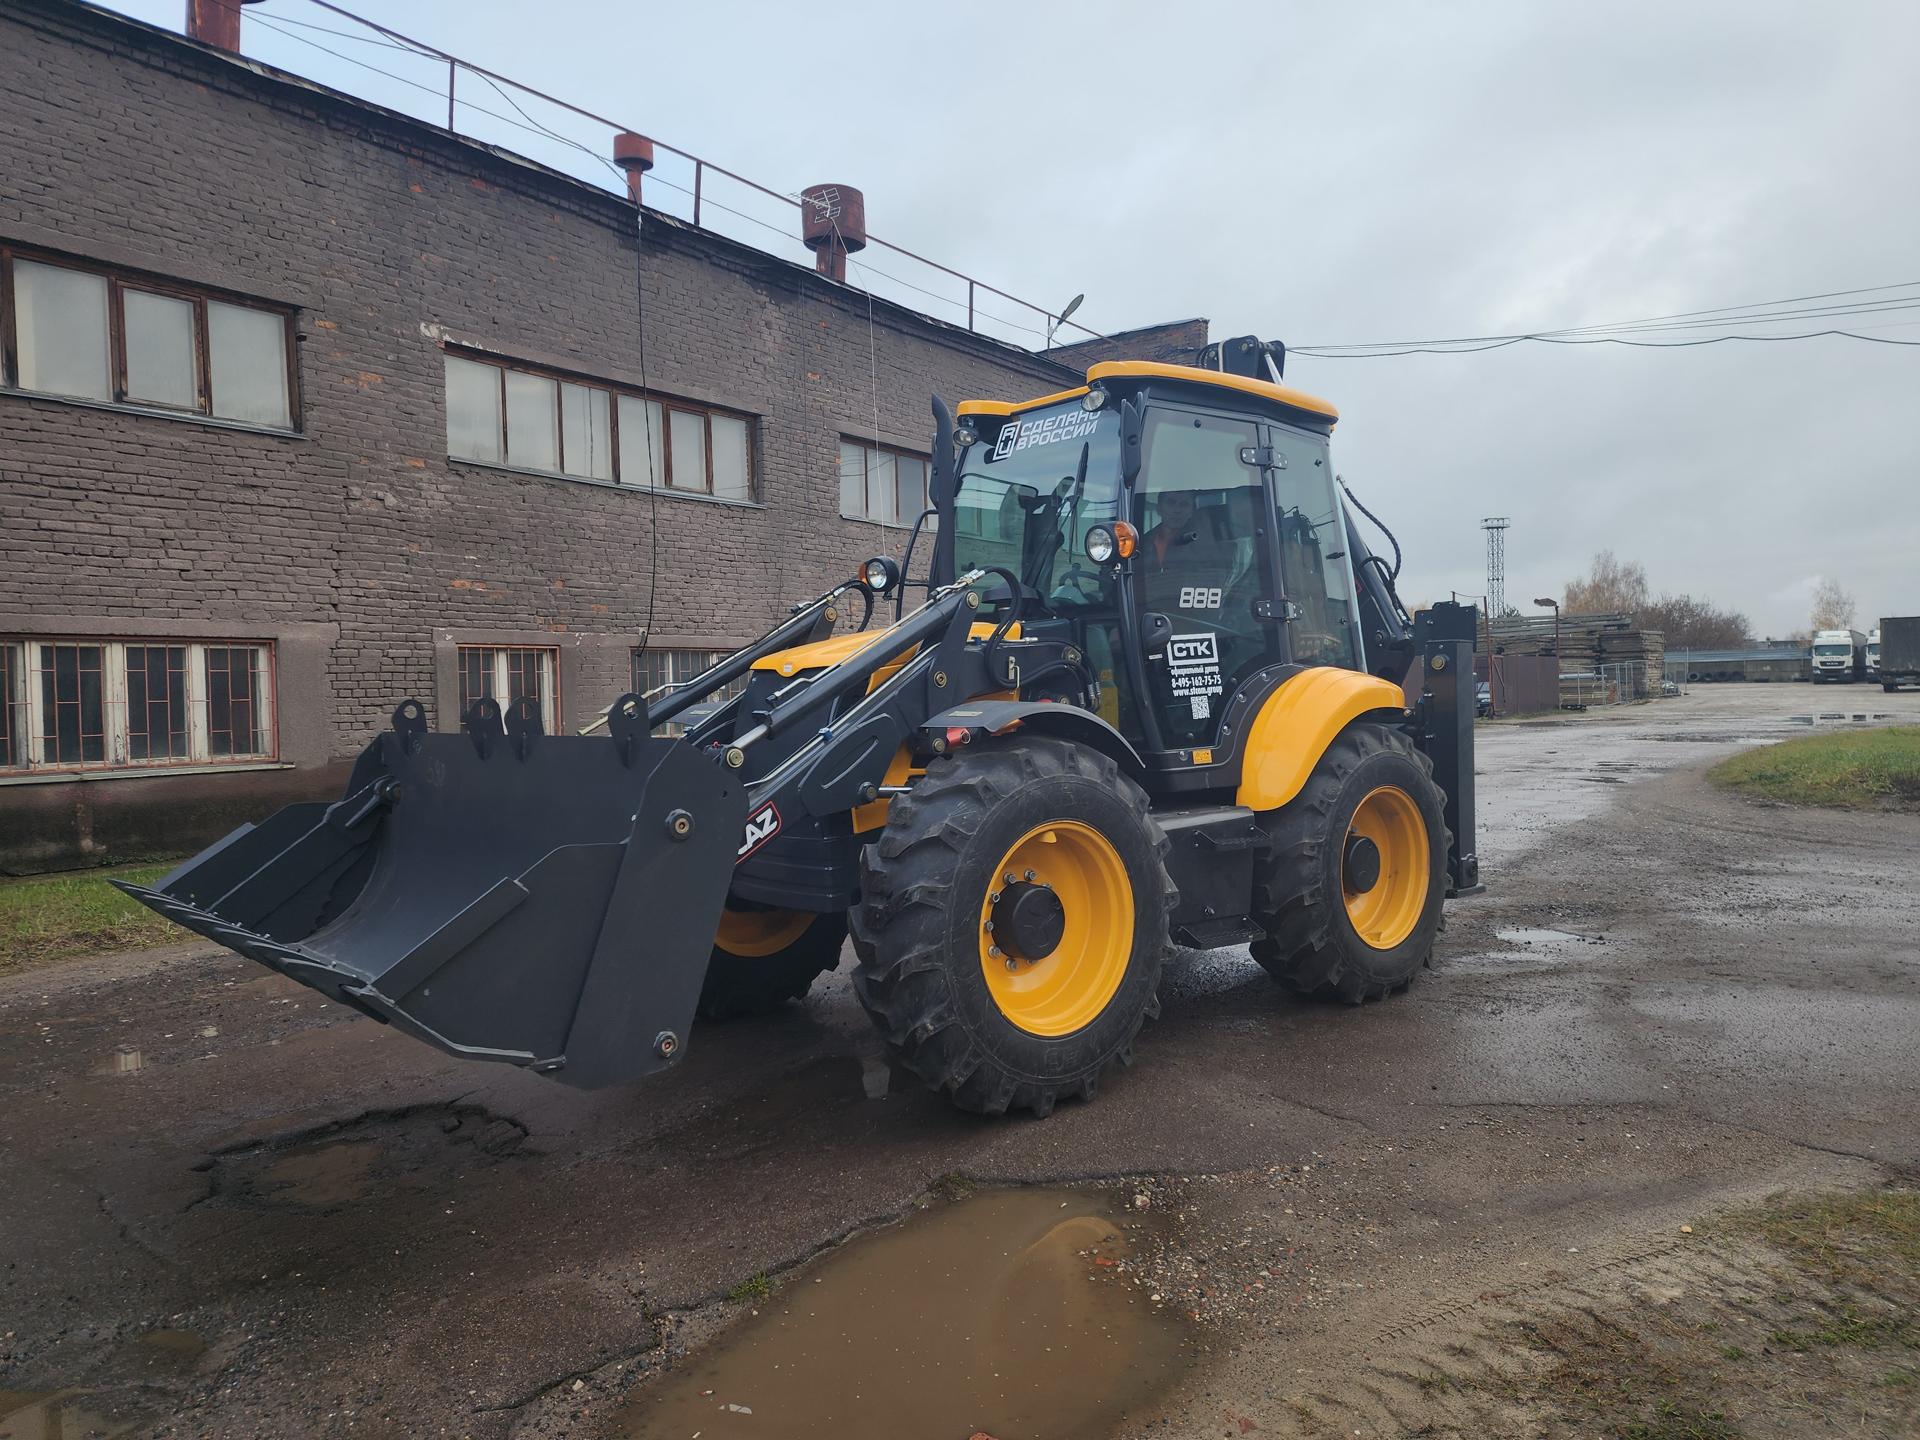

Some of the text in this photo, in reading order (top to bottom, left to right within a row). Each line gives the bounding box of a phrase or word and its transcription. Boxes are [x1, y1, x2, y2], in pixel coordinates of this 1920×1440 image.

[1021, 410, 1101, 437] СДЕЛАНО
[1179, 587, 1222, 608] 888
[1173, 641, 1211, 657] СТК
[1171, 675, 1222, 688] 8-495-162-75-75
